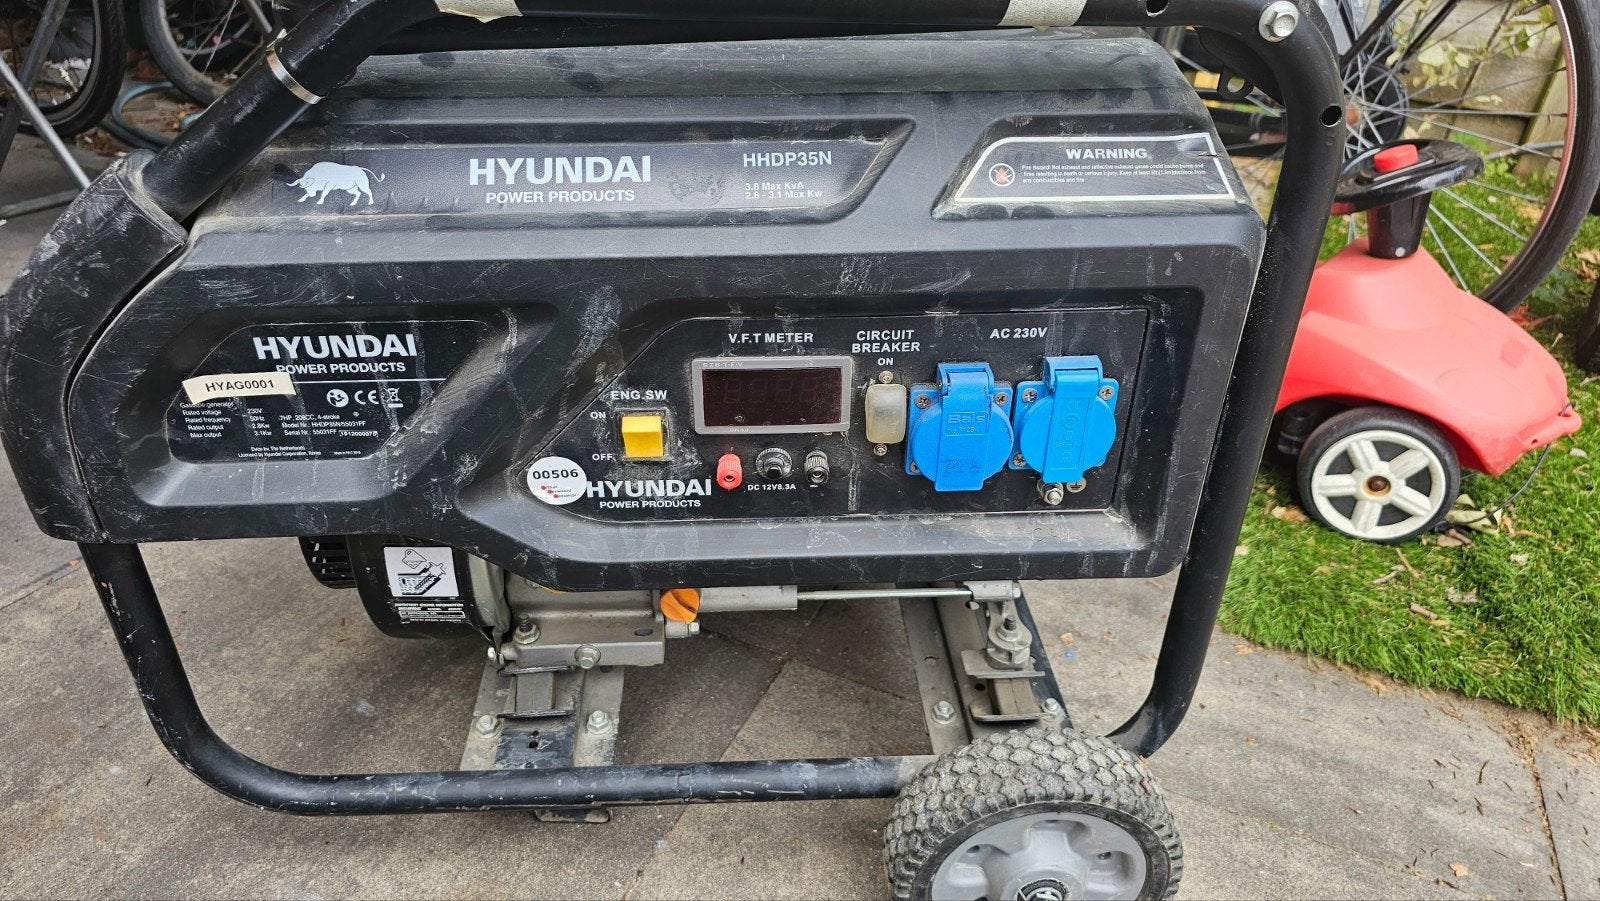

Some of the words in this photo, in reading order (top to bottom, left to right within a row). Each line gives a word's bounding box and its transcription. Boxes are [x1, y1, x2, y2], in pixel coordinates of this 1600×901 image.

[743, 150, 833, 167] HHDP35N
[1065, 148, 1148, 160] WARNING
[469, 155, 651, 186] HYUNDAI
[745, 182, 760, 191] 3.8
[761, 182, 782, 190] Max
[784, 181, 805, 189] KvA
[486, 191, 544, 203] POWER
[548, 189, 635, 203] PRODUCTS
[745, 191, 760, 199] 2.8
[768, 190, 782, 199] 3.1
[785, 190, 805, 198] Max
[807, 189, 823, 198] Kw
[728, 332, 762, 343] V.F.T
[764, 332, 814, 343] METER
[856, 329, 915, 342] CIRCUIT
[989, 327, 1013, 339] AC
[1013, 326, 1048, 339] 230V
[252, 333, 418, 360] HYUNDAI
[851, 341, 921, 353] BREAKER
[275, 362, 328, 374] POWER
[330, 361, 406, 374] PRODUCTS
[877, 357, 894, 366] ON
[204, 379, 275, 392] HYAG0001
[610, 389, 668, 401] ENG.SW
[589, 411, 606, 419] ON
[592, 453, 613, 462] OFF
[532, 468, 579, 480] 00506
[586, 478, 711, 499] HYUNDAI
[747, 483, 760, 491] DC
[762, 483, 797, 491] 12V8.3A
[599, 500, 640, 509] POWER
[641, 499, 701, 508] PRODUCTS
